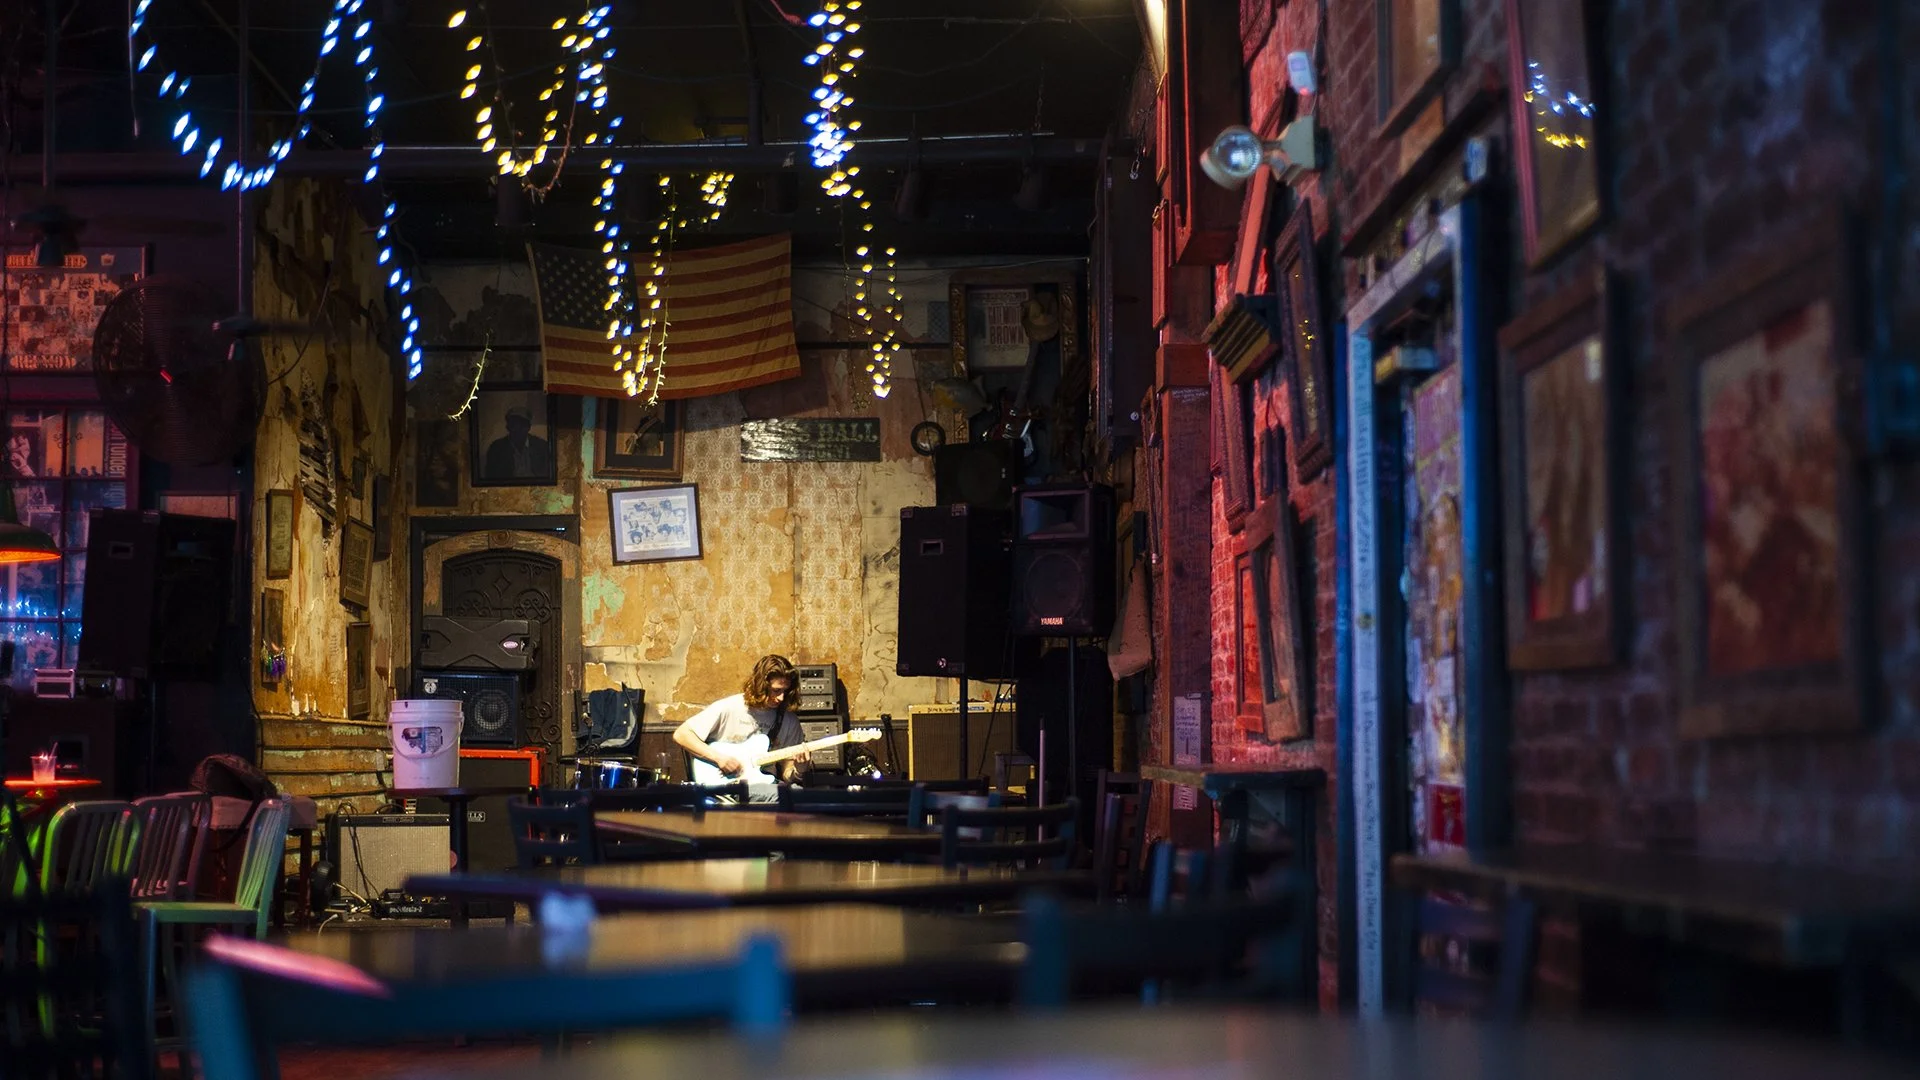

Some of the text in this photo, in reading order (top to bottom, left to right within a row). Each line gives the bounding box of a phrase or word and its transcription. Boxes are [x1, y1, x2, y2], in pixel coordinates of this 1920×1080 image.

[990, 326, 1023, 345] BROWN
[817, 422, 878, 442] HALL
[1041, 617, 1063, 625] YAMAHA
